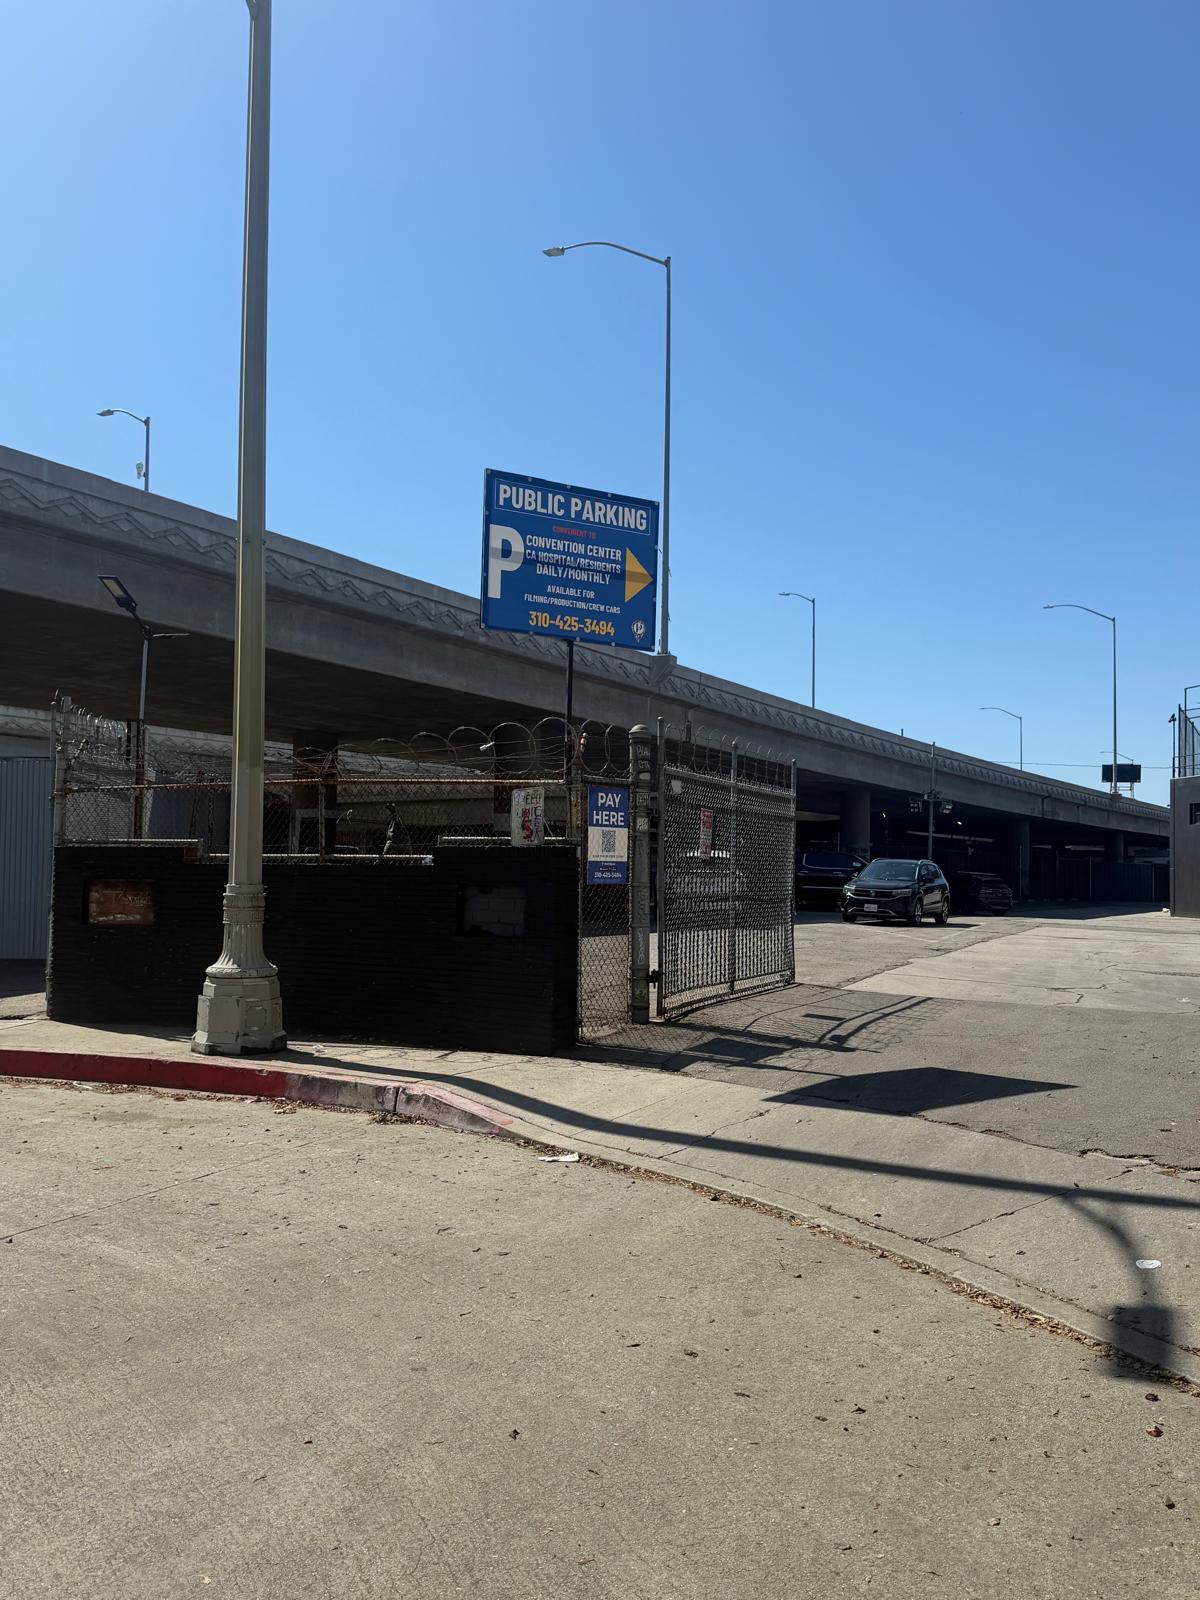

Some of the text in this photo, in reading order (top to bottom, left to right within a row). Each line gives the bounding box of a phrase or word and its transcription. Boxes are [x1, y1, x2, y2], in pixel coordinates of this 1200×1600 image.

[499, 484, 647, 530] PUBLIC PARKING
[526, 535, 622, 561] CONVENTION CENTER
[487, 524, 524, 599] P
[526, 550, 621, 574] CA HOSPITAL/RESIDENTS
[536, 564, 611, 585] DAILY/MONTHLY
[547, 585, 595, 599] AVAILABLE FOR
[524, 594, 621, 615] FILMING/PRODUCTION/CREW CARS
[529, 610, 615, 636] 310-425-3494
[598, 792, 621, 808] PAY
[593, 810, 625, 826] HERE
